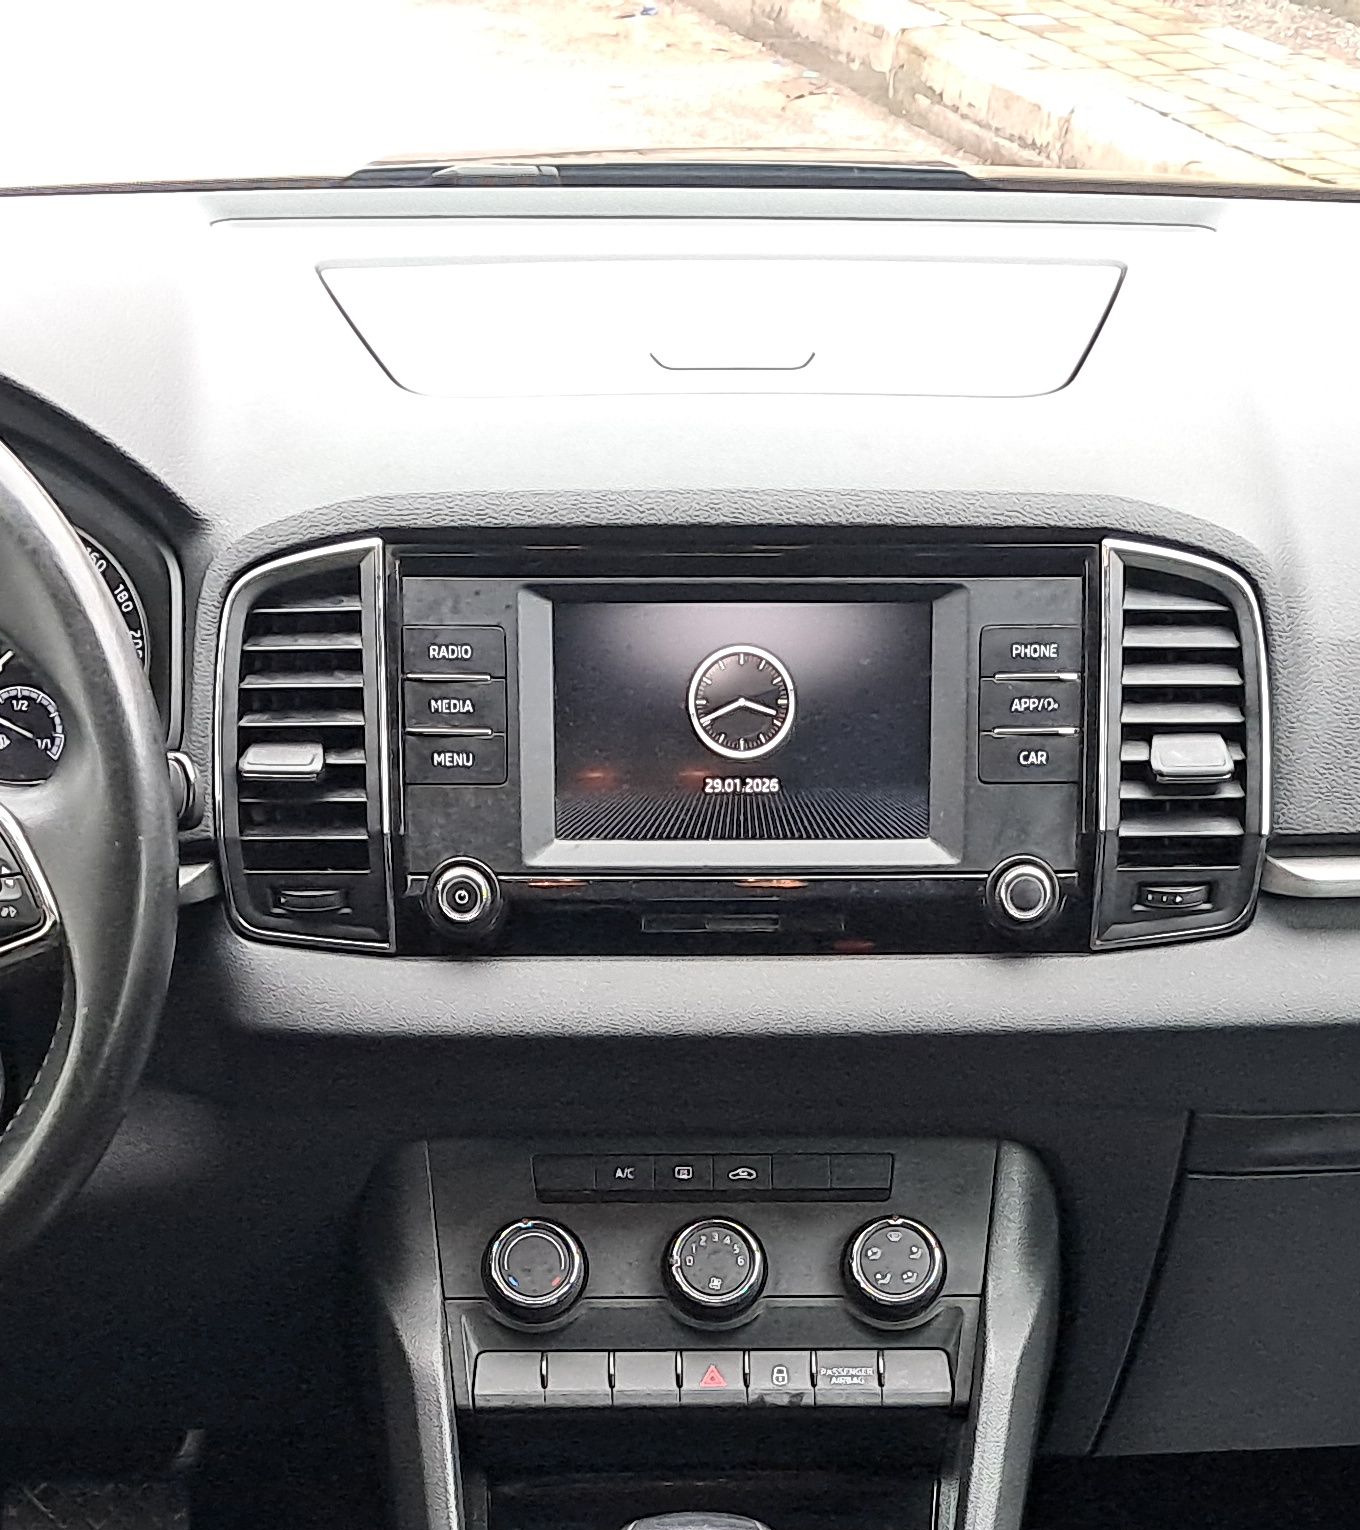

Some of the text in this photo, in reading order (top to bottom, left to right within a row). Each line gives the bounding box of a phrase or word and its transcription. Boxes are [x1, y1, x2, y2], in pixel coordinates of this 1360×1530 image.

[114, 583, 134, 612] 180
[429, 645, 472, 660] RADIO
[1012, 644, 1058, 659] PHONE
[11, 700, 29, 712] 1/2
[429, 699, 474, 714] MEDIA
[433, 752, 474, 767] MENU
[1019, 751, 1047, 766] CAR
[704, 778, 780, 794] 29.01.2026
[615, 1167, 635, 1179] A/C
[820, 1367, 874, 1376] PASSENGER
